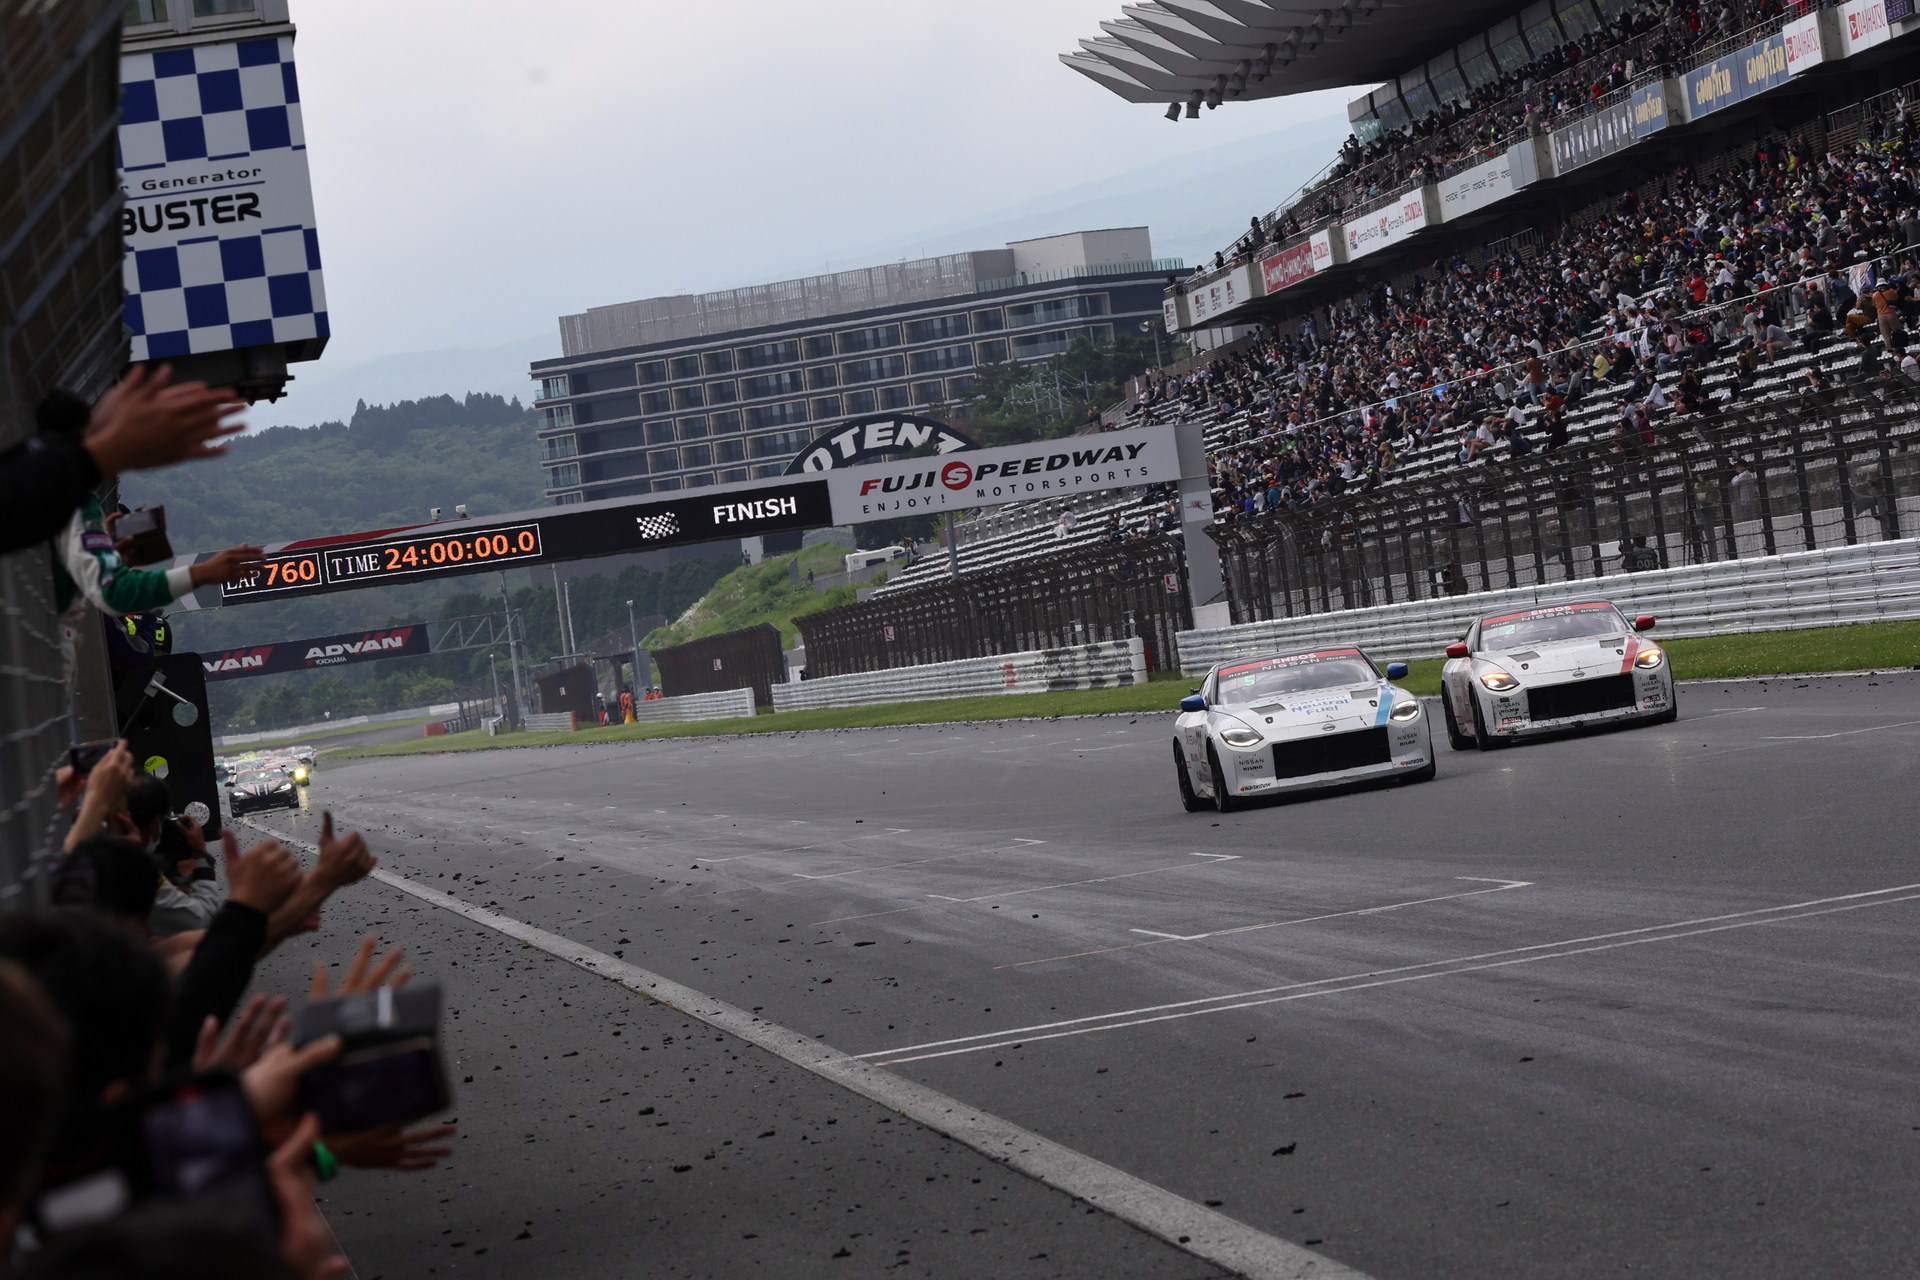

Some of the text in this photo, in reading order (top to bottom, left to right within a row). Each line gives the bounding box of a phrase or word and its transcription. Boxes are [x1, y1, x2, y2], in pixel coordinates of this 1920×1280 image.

[1746, 41, 1785, 87] GOODYEAR
[1696, 64, 1731, 107] GOODYEAR
[1635, 93, 1662, 124] GOODYEAR
[141, 168, 262, 191] Generator
[122, 192, 262, 237] BUSTER
[859, 442, 1148, 496] FUJI SPEEDWAY
[863, 466, 1149, 514] ENJOY! MOTORSPORTS
[713, 496, 797, 524] FINISH
[331, 531, 535, 576] TIME 24:00:00.0
[264, 560, 316, 586] 760
[1521, 610, 1575, 622] NISSAN
[1531, 605, 1572, 616] ENEOS
[304, 636, 403, 659] ADVAN
[1271, 653, 1316, 665] ENEOS
[315, 656, 347, 665] YOKOHAMA
[1262, 658, 1320, 671] NISSAN
[1291, 699, 1349, 713] Neutral
[1306, 705, 1339, 716] Fuel
[1239, 758, 1265, 766] NISSAN
